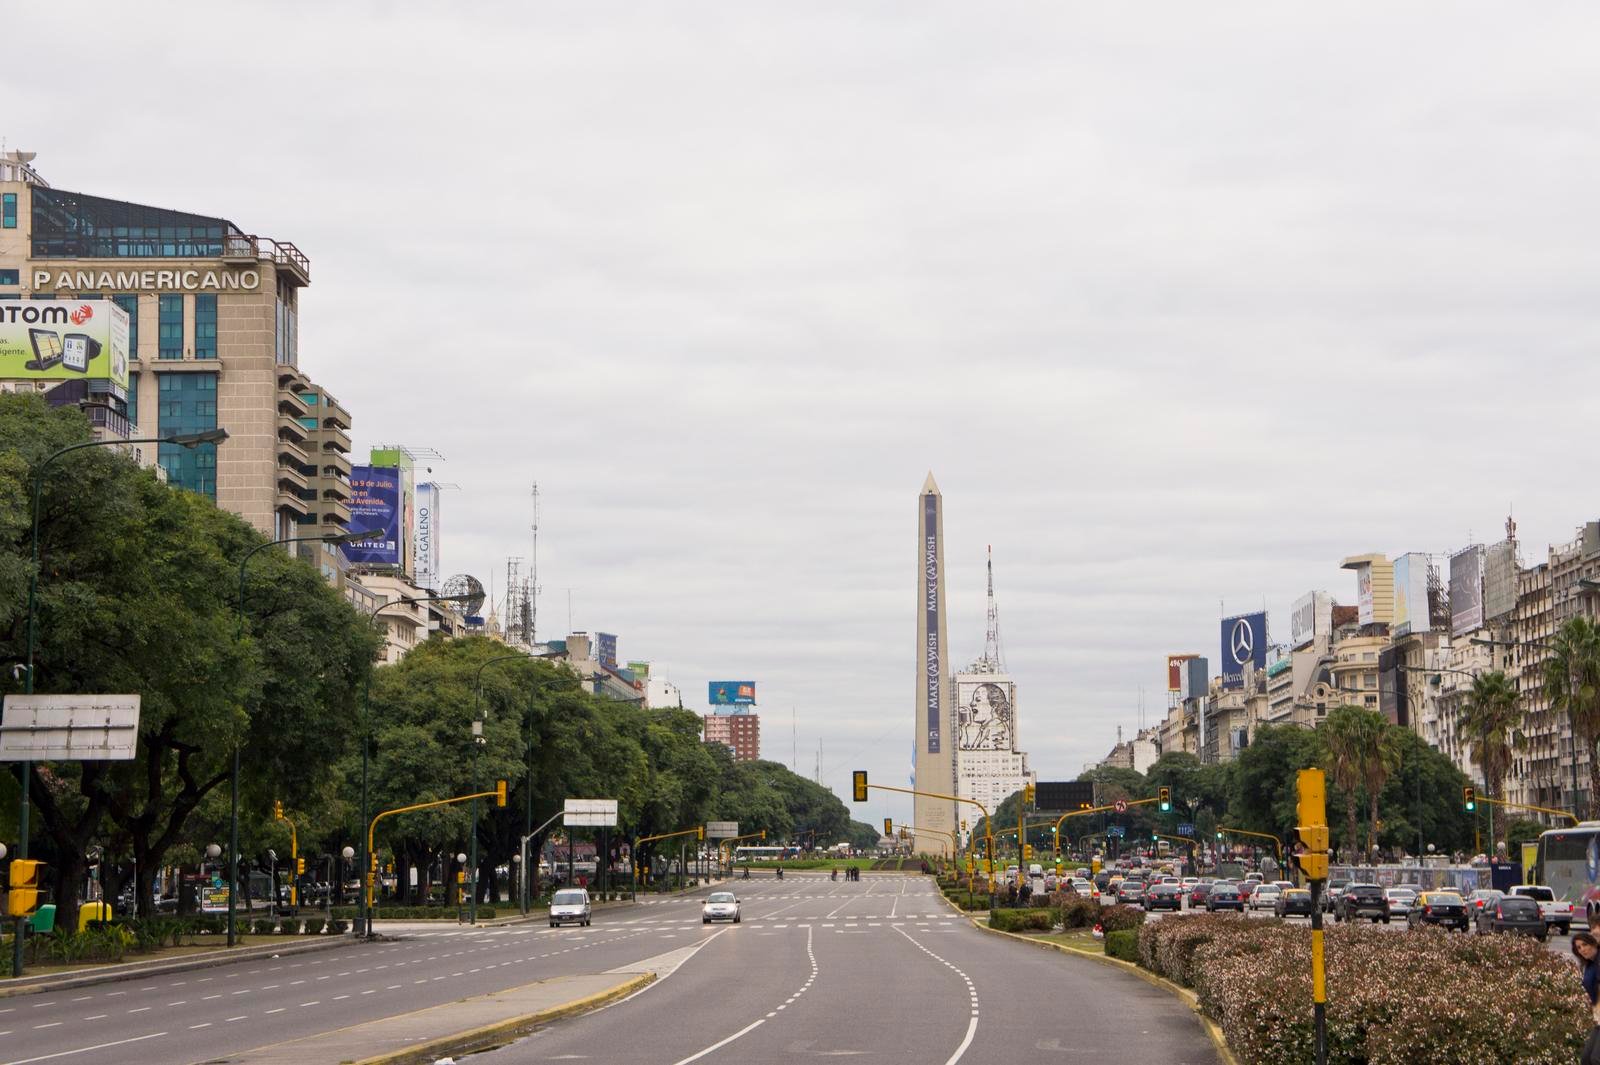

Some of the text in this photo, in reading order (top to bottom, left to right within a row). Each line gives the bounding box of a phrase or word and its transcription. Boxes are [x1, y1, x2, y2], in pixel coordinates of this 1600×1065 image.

[34, 270, 259, 290] PANAMERICANO
[420, 508, 429, 552] GALENO
[350, 541, 385, 549] UNITED
[926, 536, 937, 563] WISH
[928, 581, 937, 612] MAKE
[927, 633, 939, 661] WISH
[929, 678, 939, 709] MAKE
